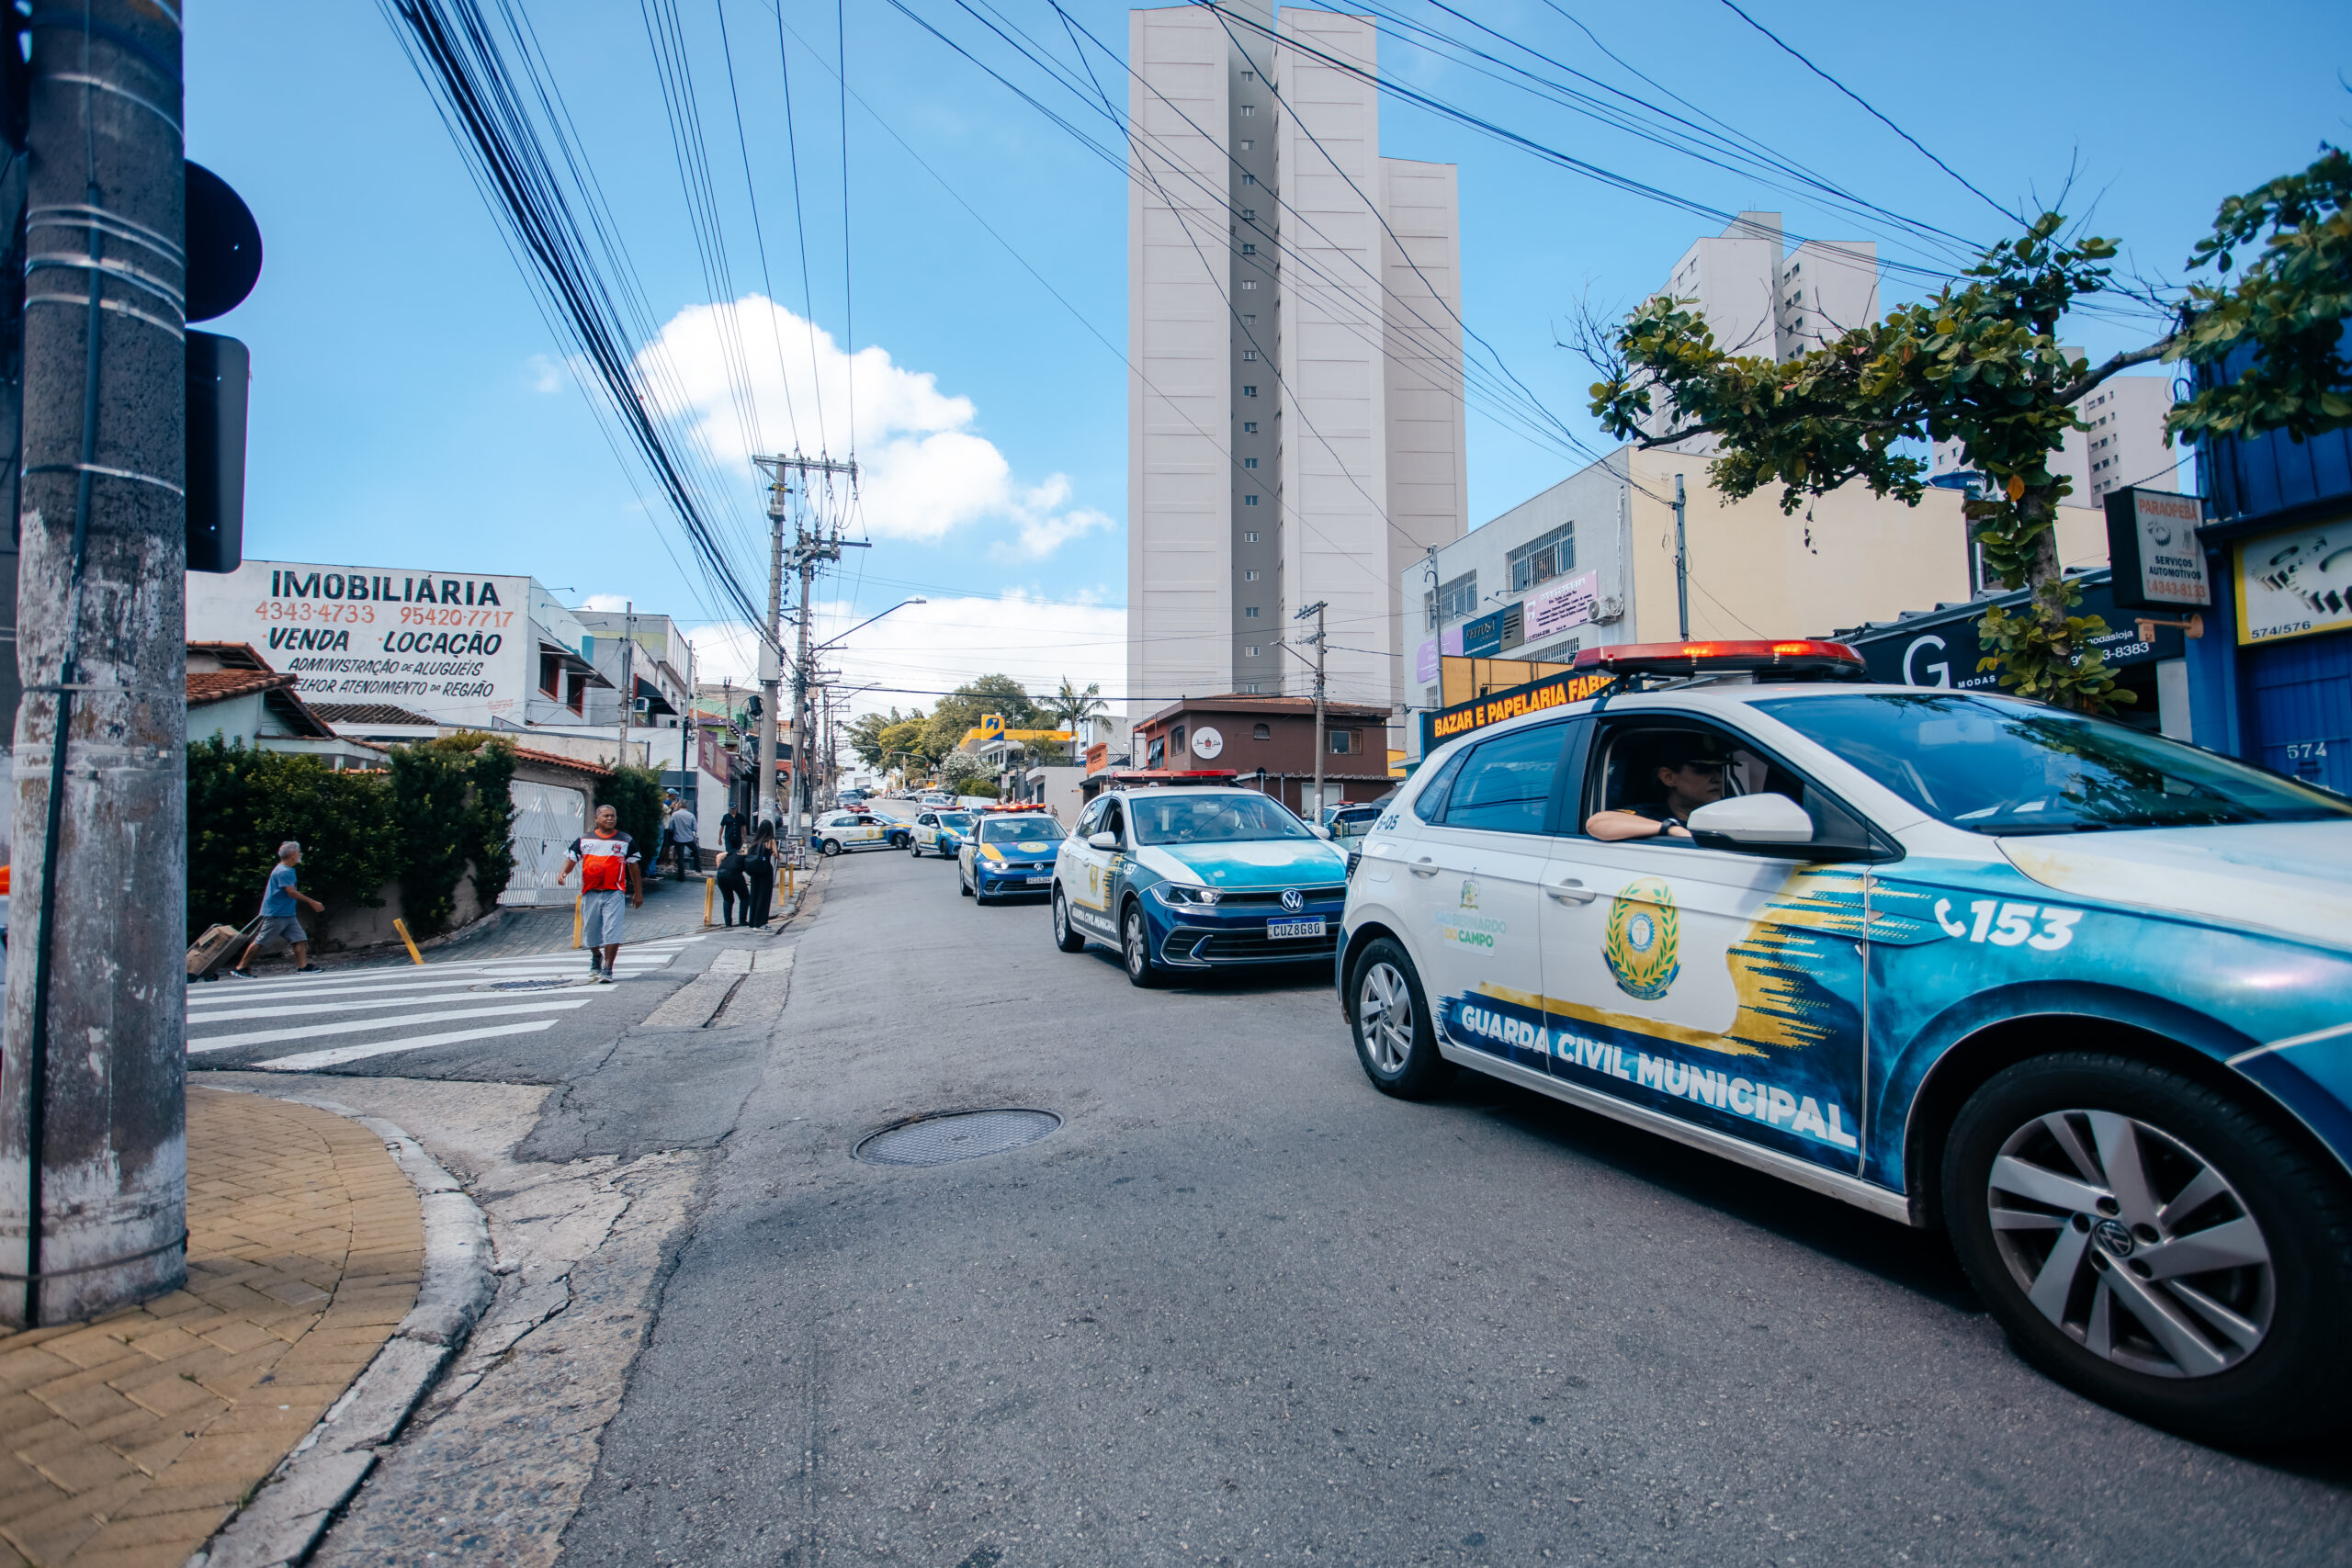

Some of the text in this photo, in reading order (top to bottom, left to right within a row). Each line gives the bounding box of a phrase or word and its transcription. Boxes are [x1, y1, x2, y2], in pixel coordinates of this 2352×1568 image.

[2138, 499, 2198, 521] PARAOPEBA
[2148, 567, 2202, 581] AUTOMOTIVOS
[272, 570, 502, 606] IMOBILIÁRIA
[2251, 621, 2312, 639] 574/576
[269, 626, 503, 658] VENDA LOCAÇÃO
[288, 658, 400, 676] ADMINISTRAÇÃO
[401, 663, 413, 671] DE
[1903, 635, 1996, 689] G MODAS
[292, 678, 337, 693] ELHOR
[339, 679, 428, 695] ATENDIMENTO
[442, 680, 494, 697] REGIÃO
[1434, 708, 1474, 738] BAZAR
[1476, 705, 1486, 727] E
[1487, 682, 1567, 724] PAPELARIA
[2287, 741, 2327, 760] 574
[1273, 922, 1320, 936] CUZ8G80
[1969, 899, 2084, 951] 153
[1458, 929, 1494, 948] CAMPO
[1462, 1005, 1858, 1149] GUARDA CIVIL MUNICIPAL
